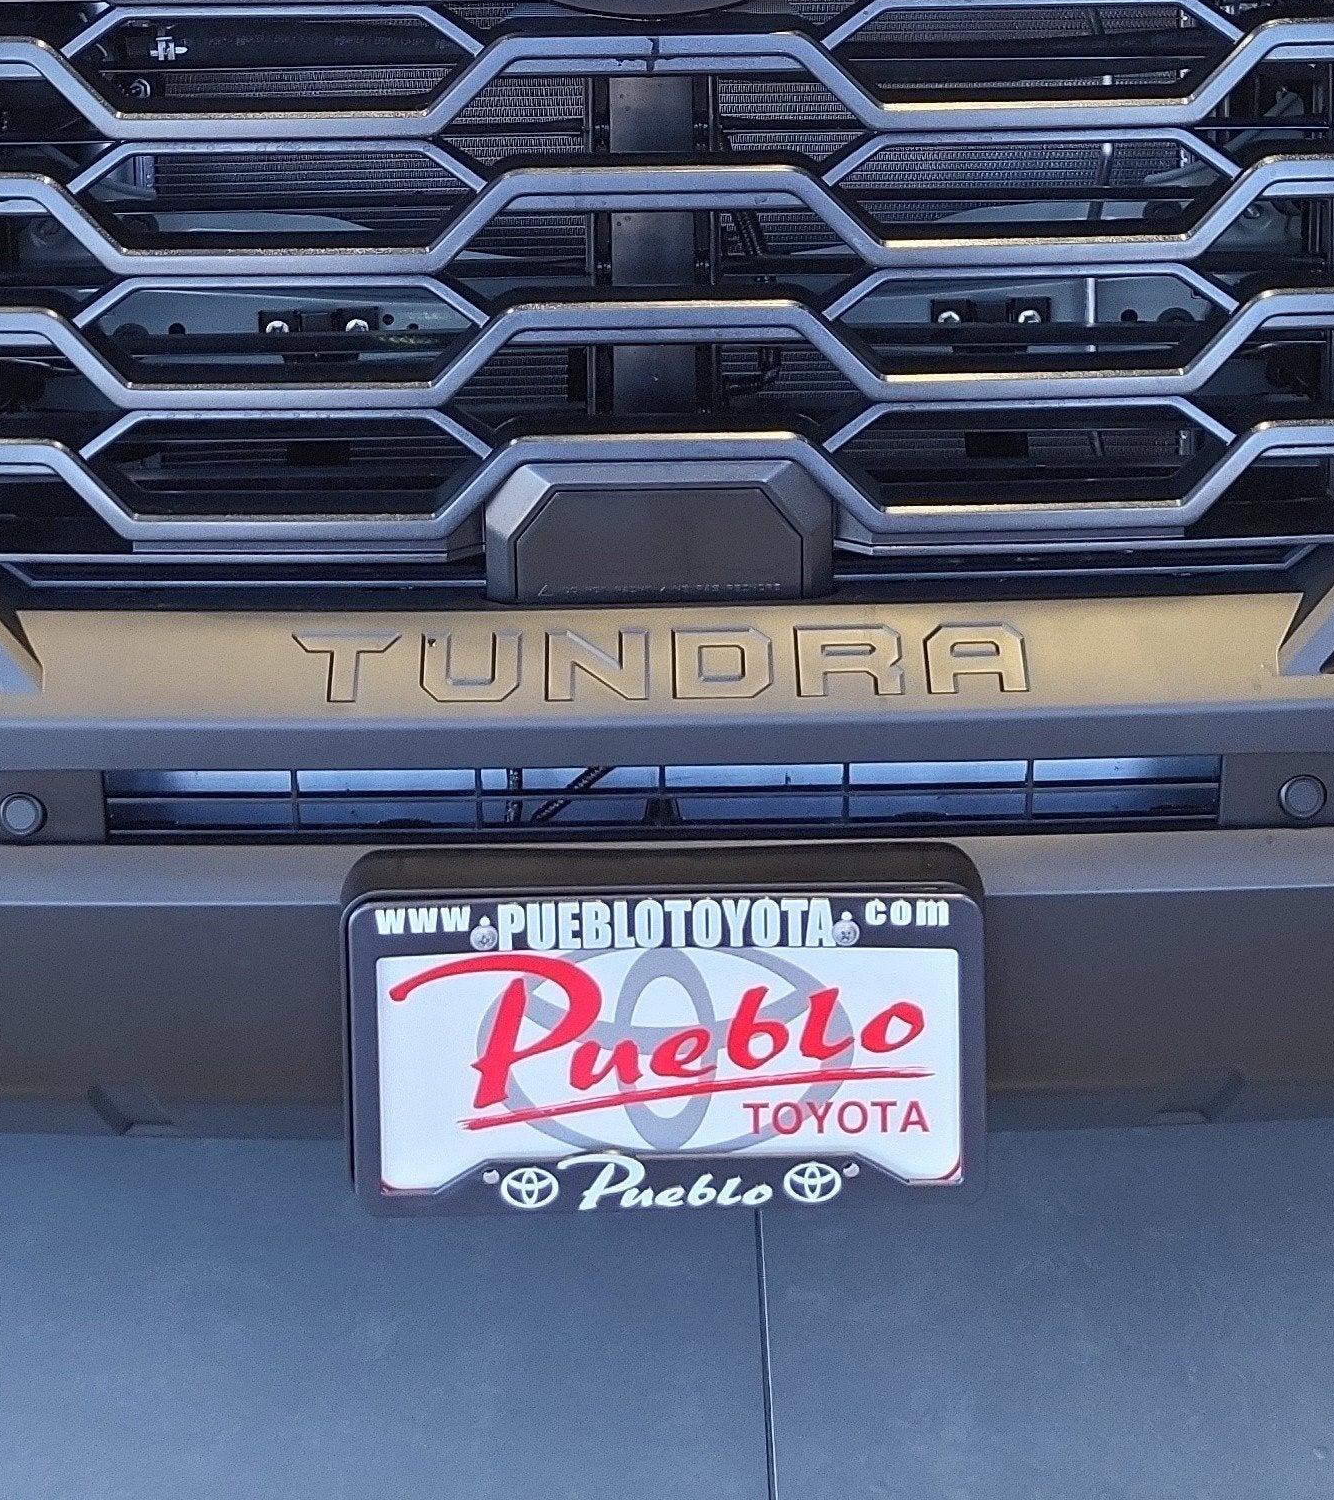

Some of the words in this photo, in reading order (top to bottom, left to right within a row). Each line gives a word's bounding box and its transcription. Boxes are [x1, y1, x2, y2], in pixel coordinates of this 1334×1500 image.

[292, 622, 1030, 703] TUNDRA
[388, 953, 926, 1109] Pueblo
[742, 1100, 930, 1136] TOYOTA
[557, 1152, 774, 1211] Pueblo
